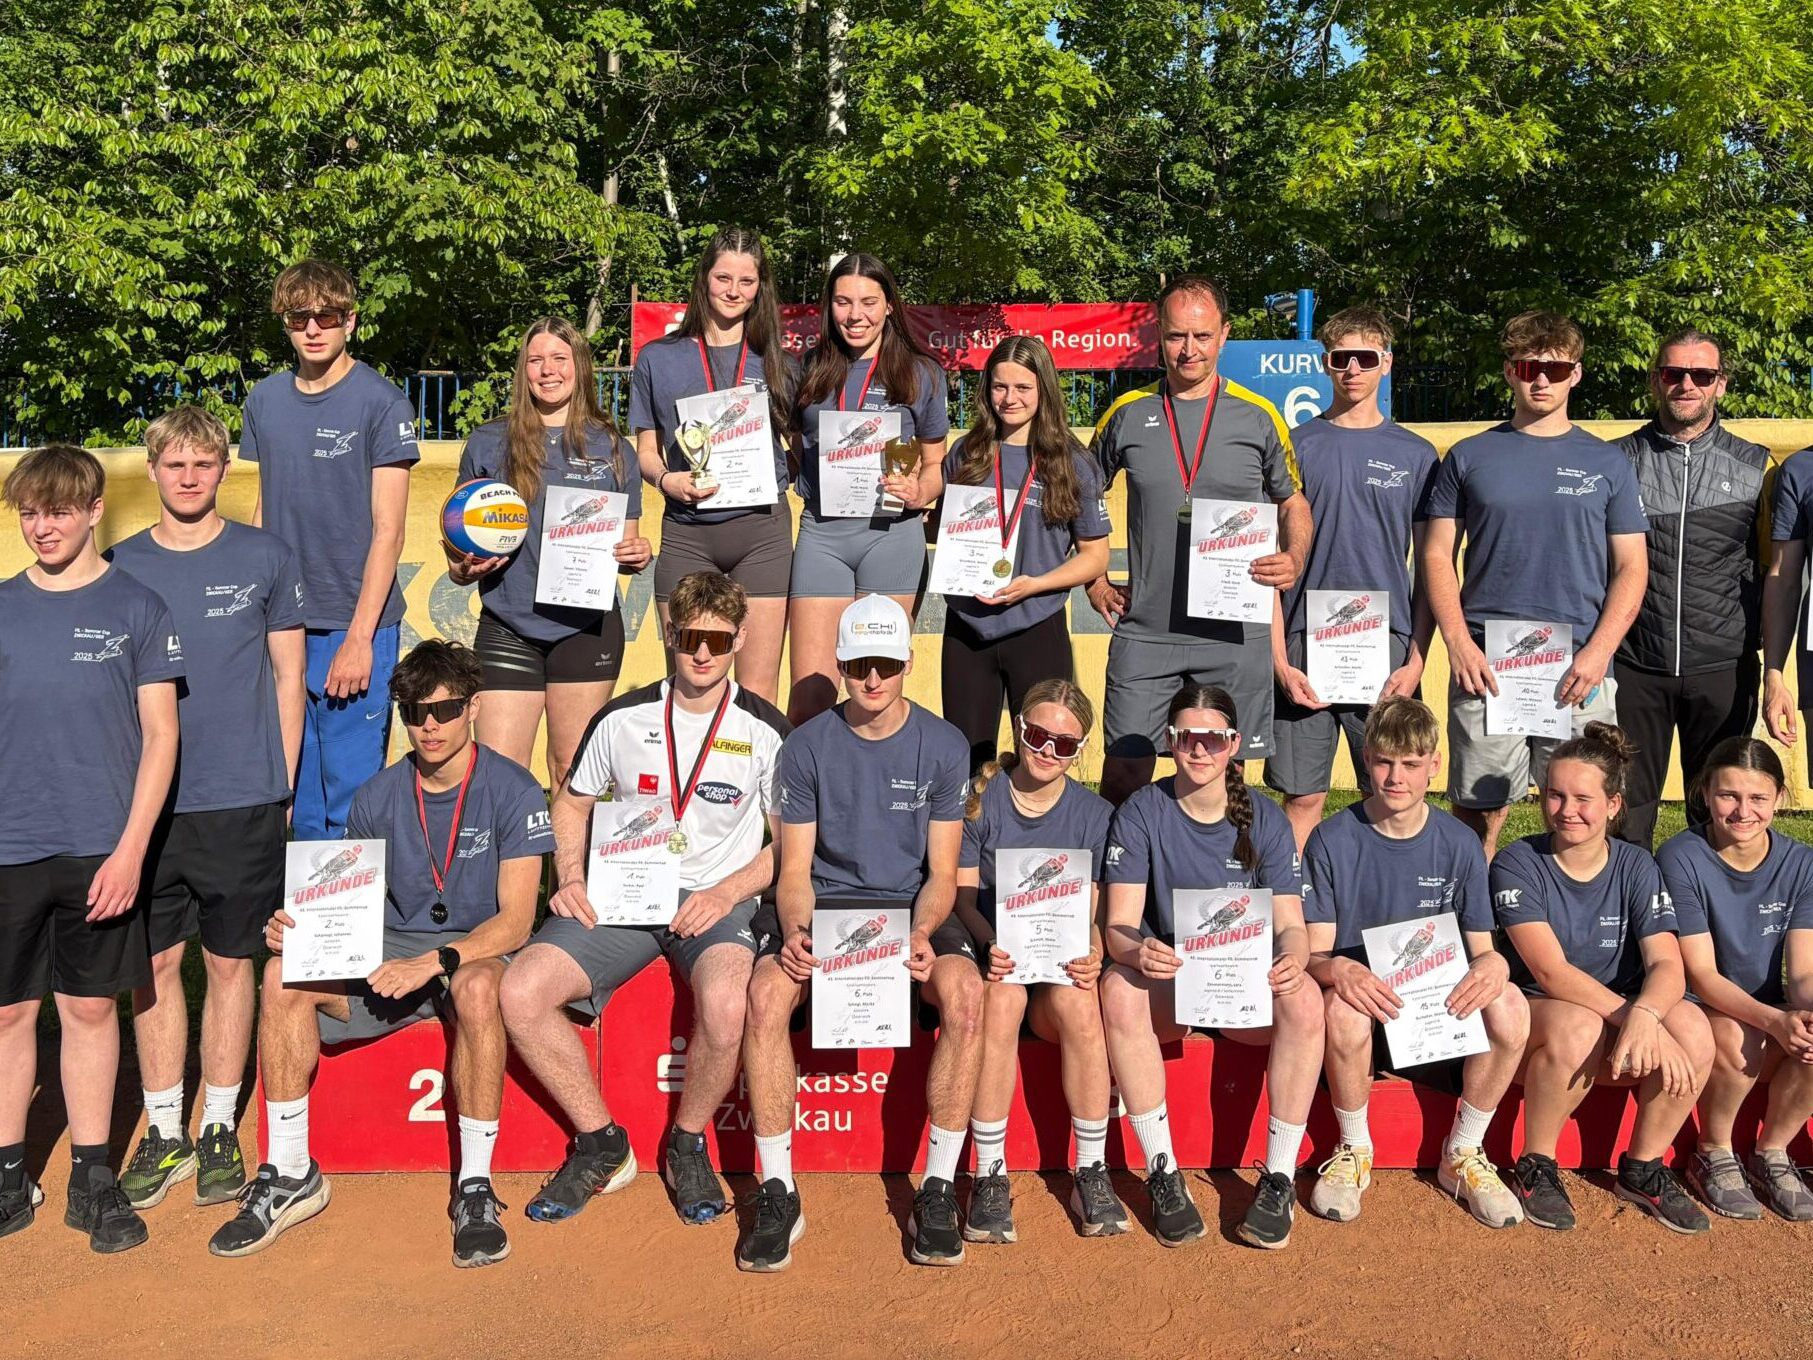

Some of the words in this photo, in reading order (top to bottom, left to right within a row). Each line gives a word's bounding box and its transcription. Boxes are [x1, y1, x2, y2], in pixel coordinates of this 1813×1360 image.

[928, 330, 966, 349] Gut
[1052, 329, 1138, 352] Region.
[1260, 353, 1325, 374] KURV
[1284, 385, 1322, 430] 6
[710, 418, 763, 446] RKUNDE
[827, 441, 884, 462] URKUND
[480, 490, 512, 500] BEACH
[548, 519, 617, 541] URKUNDE
[1198, 530, 1269, 554] URKUNDE
[1315, 617, 1381, 642] URKUNDE
[74, 651, 93, 660] 2025
[1494, 650, 1565, 674] URKUNDE
[697, 784, 739, 796] personal
[704, 790, 728, 801] shop
[294, 869, 376, 906] URKUNDE
[1005, 880, 1081, 912] URKUNDE
[1184, 921, 1265, 954] URKUNDE
[821, 940, 901, 975] URKUNDE
[408, 1067, 447, 1122] 2
